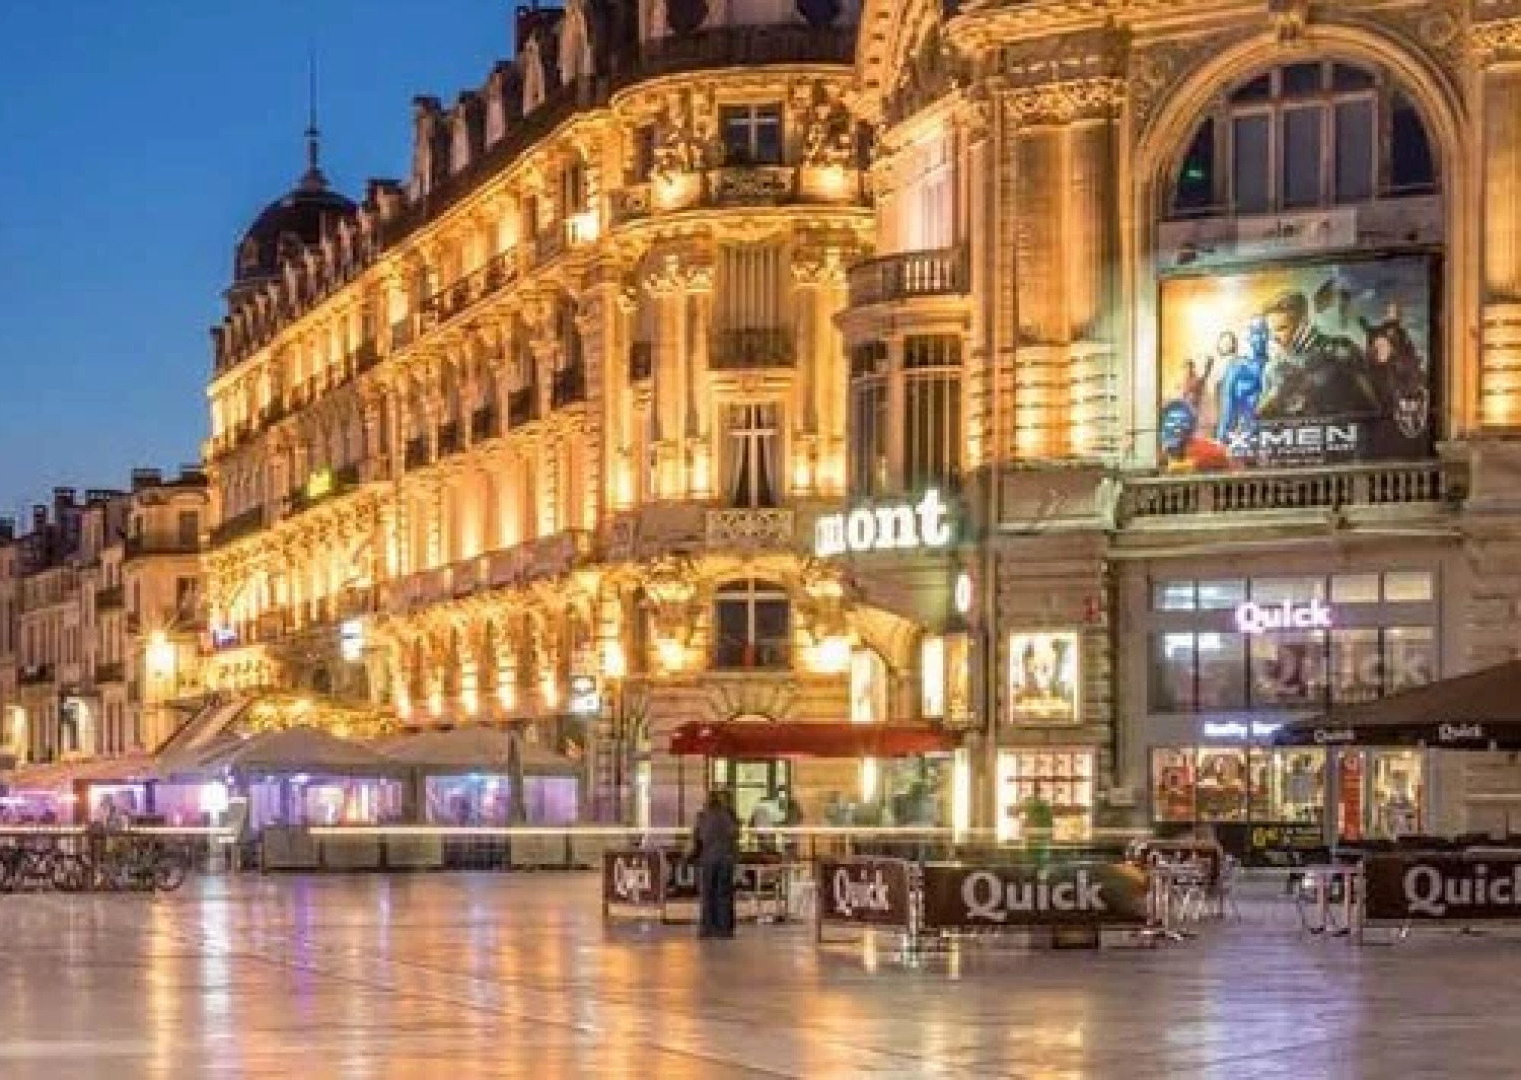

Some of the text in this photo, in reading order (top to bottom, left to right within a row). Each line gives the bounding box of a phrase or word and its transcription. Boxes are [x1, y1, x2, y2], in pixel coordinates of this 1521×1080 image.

[1228, 423, 1358, 449] X-MEN
[1235, 598, 1332, 634] Quick
[833, 867, 890, 915] Quick
[961, 869, 1108, 922] Quick
[1403, 864, 1521, 916] Quic
